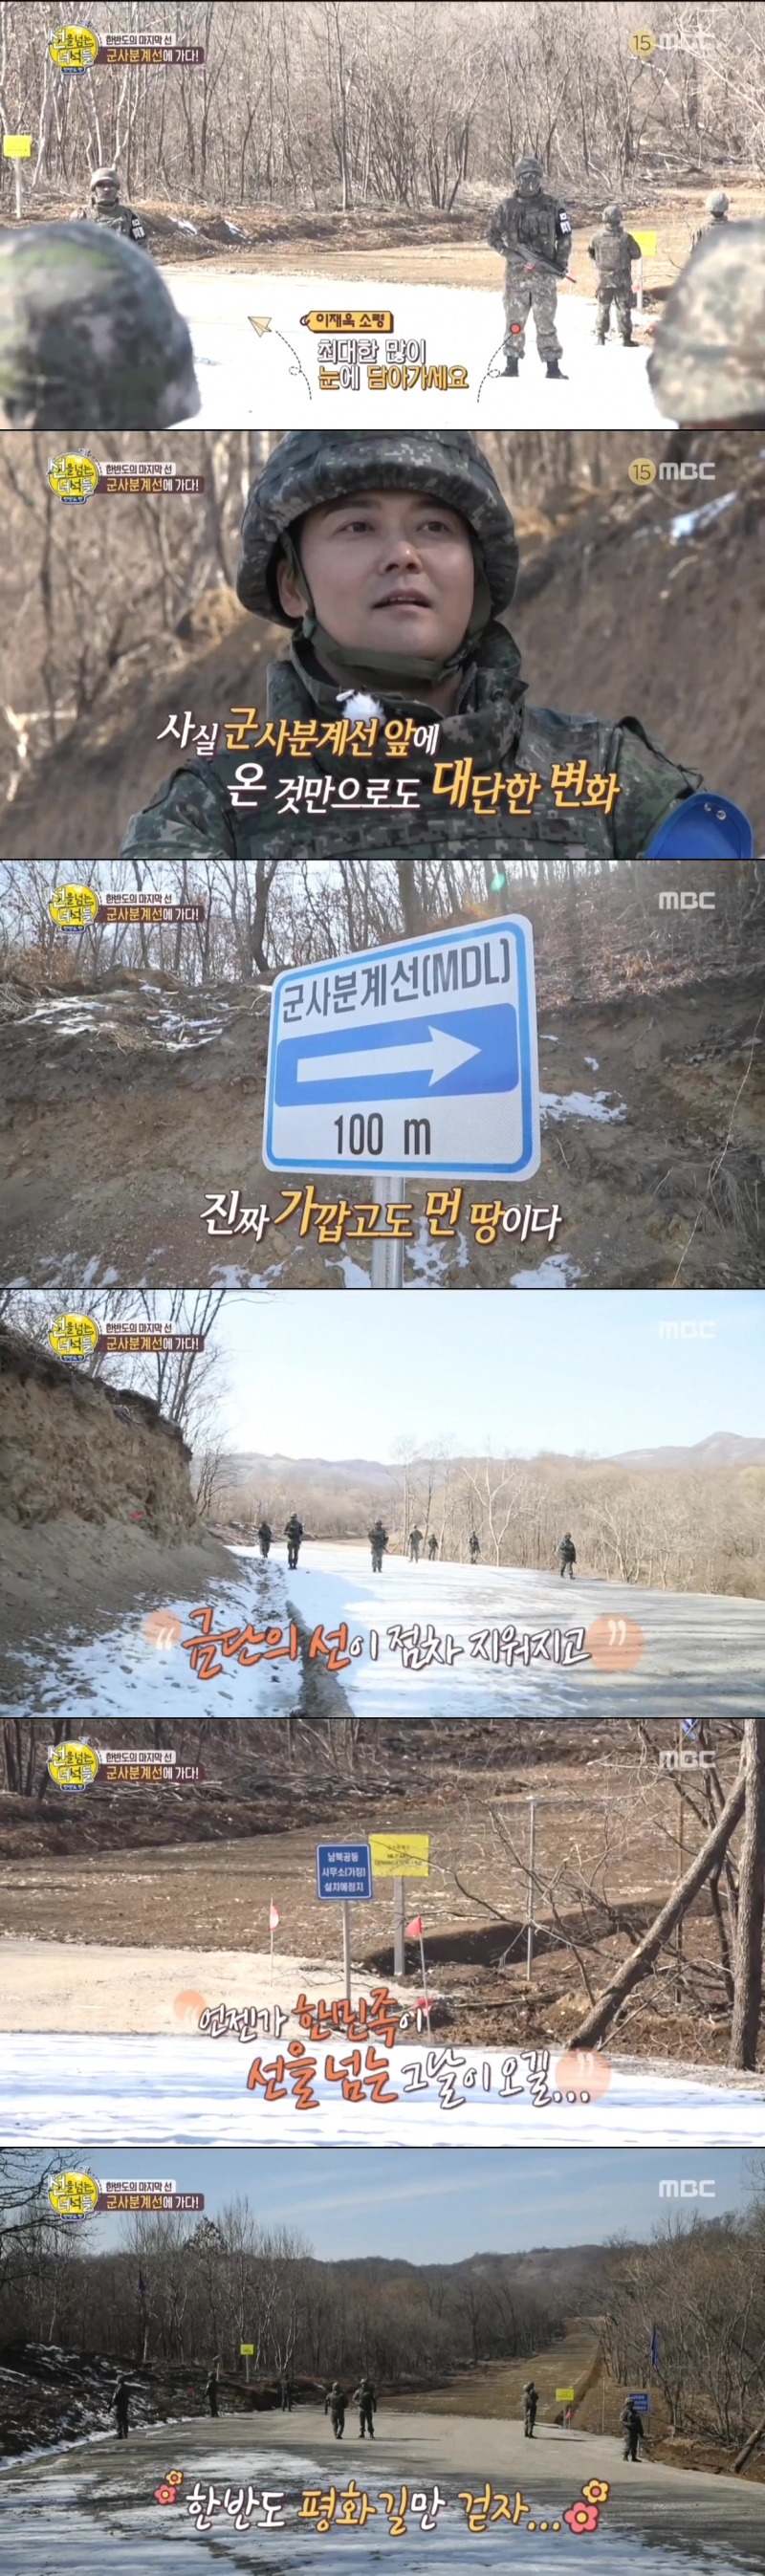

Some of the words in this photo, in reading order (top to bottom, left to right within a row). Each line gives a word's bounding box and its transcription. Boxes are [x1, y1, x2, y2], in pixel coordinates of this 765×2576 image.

[334, 1112, 383, 1155] 100
[404, 1117, 431, 1155] m
[327, 1851, 360, 1863] 남북공동
